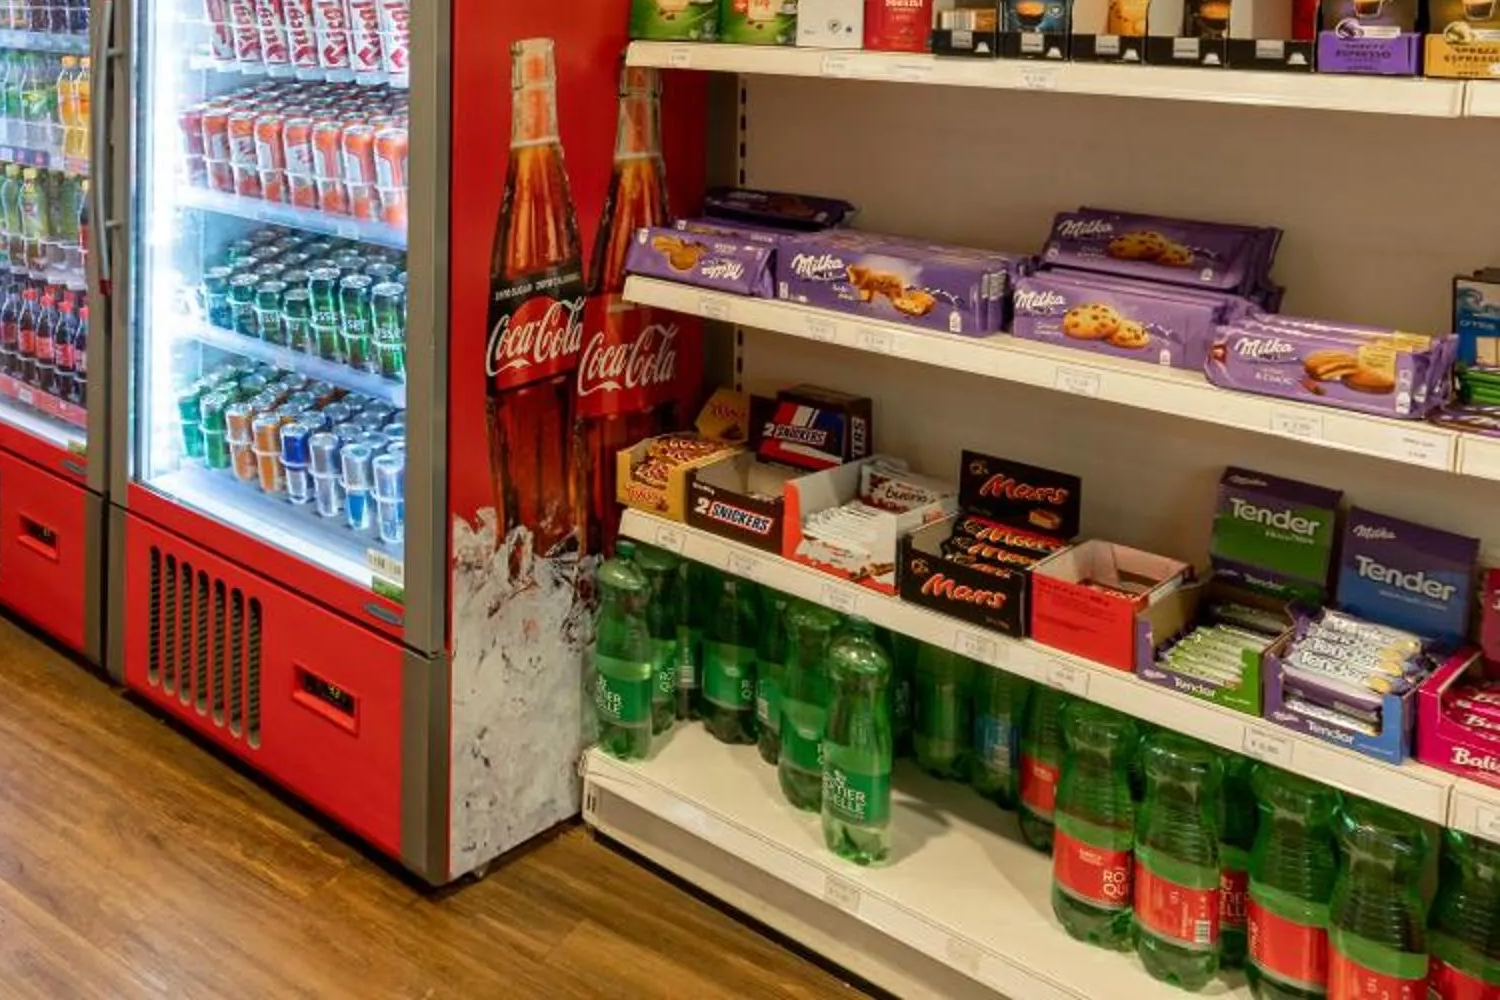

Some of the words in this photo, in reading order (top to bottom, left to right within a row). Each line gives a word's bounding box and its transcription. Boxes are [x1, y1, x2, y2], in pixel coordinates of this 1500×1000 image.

[1056, 218, 1114, 238] Milka
[791, 253, 845, 277] Milka
[1013, 290, 1067, 310] Milka
[485, 295, 587, 378] Coca-Cola
[1233, 336, 1296, 358] Milka
[577, 322, 679, 397] Coca-Cola
[775, 424, 827, 445] SNICKERS
[980, 473, 1069, 505] Mars
[693, 497, 710, 514] 2
[710, 501, 771, 533] SNICKERS
[1230, 497, 1321, 536] Tender
[921, 573, 1007, 609] Mars
[1355, 554, 1457, 601] Tender
[1307, 719, 1355, 746] Tender
